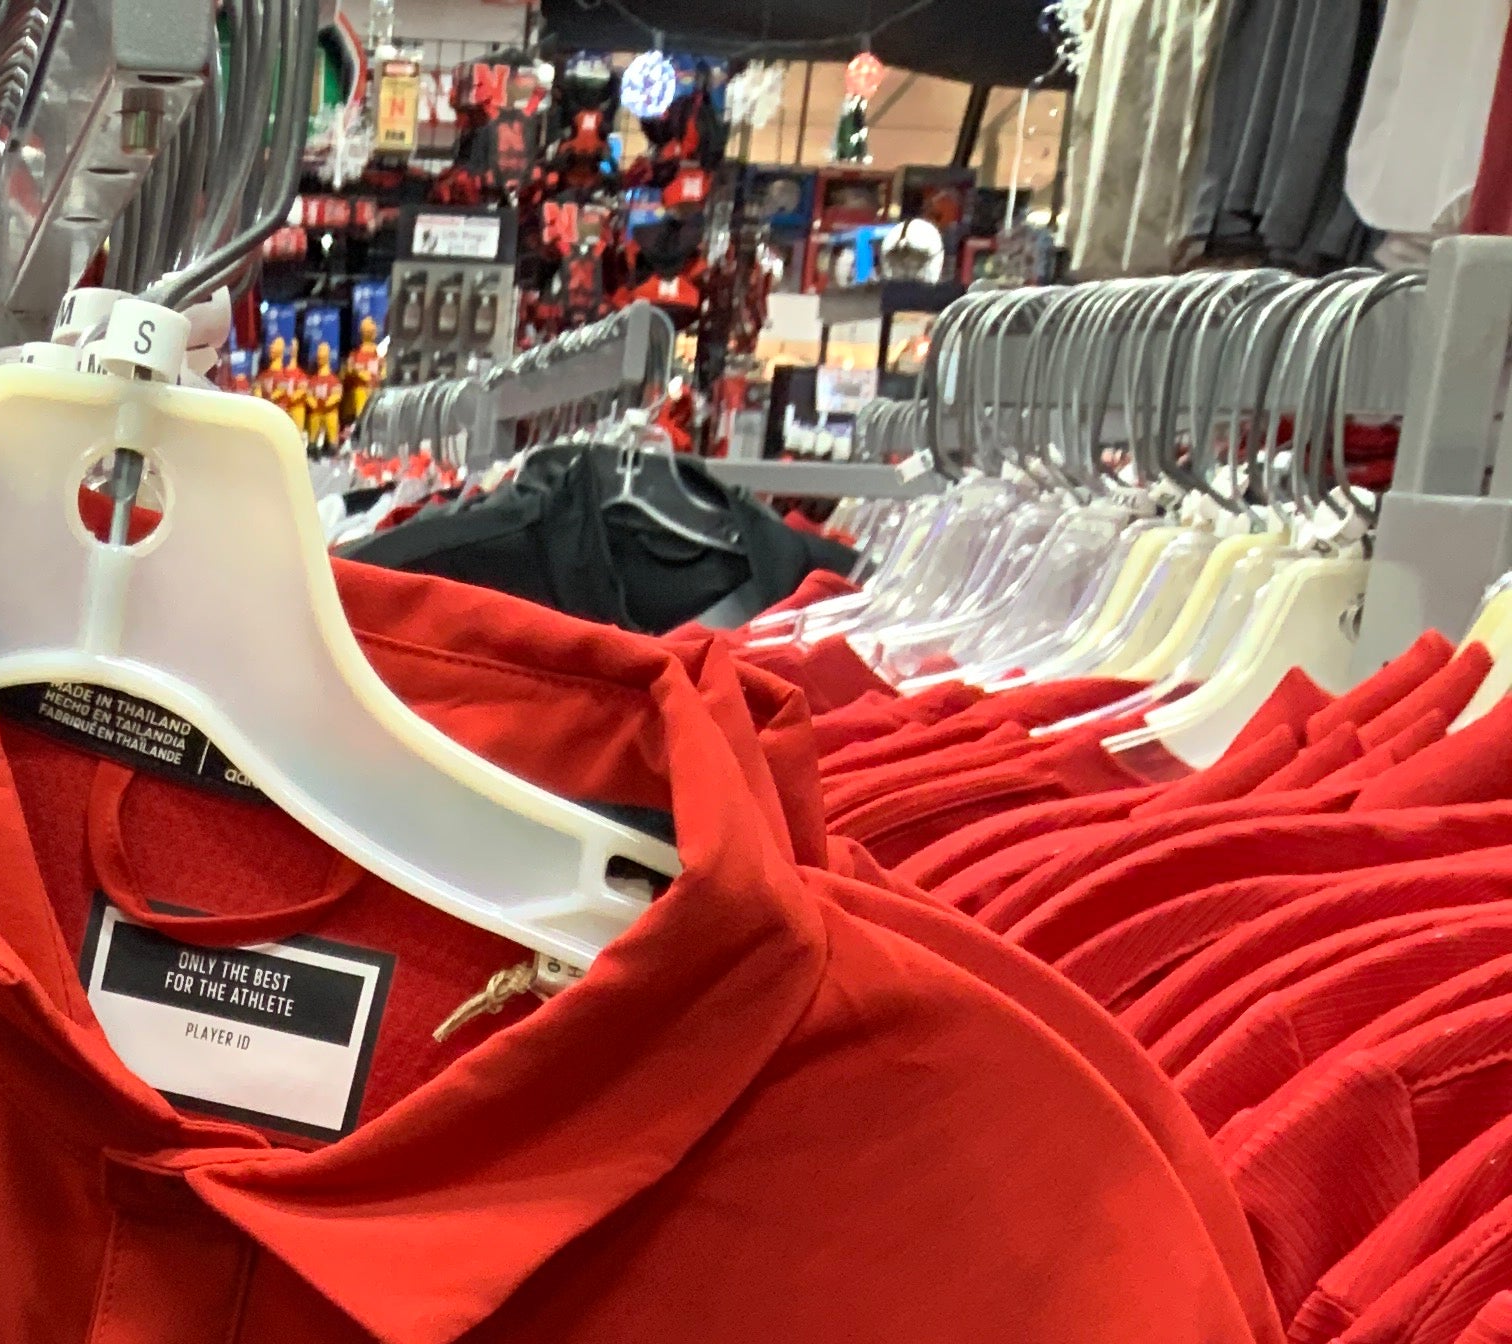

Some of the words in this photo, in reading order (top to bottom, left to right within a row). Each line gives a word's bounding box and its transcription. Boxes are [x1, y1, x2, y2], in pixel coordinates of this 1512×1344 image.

[134, 319, 156, 355] S
[39, 703, 96, 735] FABRIQUÉ
[97, 726, 114, 743] EN
[44, 690, 90, 716] HECHO
[93, 707, 112, 724] EN
[115, 713, 186, 750] TAILANDIA
[95, 692, 112, 709] IN
[117, 699, 192, 736] THAILAND
[178, 951, 217, 975] ONLY
[222, 961, 250, 983] THE
[253, 968, 291, 992] BEST
[164, 971, 194, 994] FOR
[199, 979, 227, 1001] THE
[229, 987, 295, 1017] ATHLETE
[185, 1022, 233, 1046] PLAYER
[236, 1033, 251, 1050] ID
